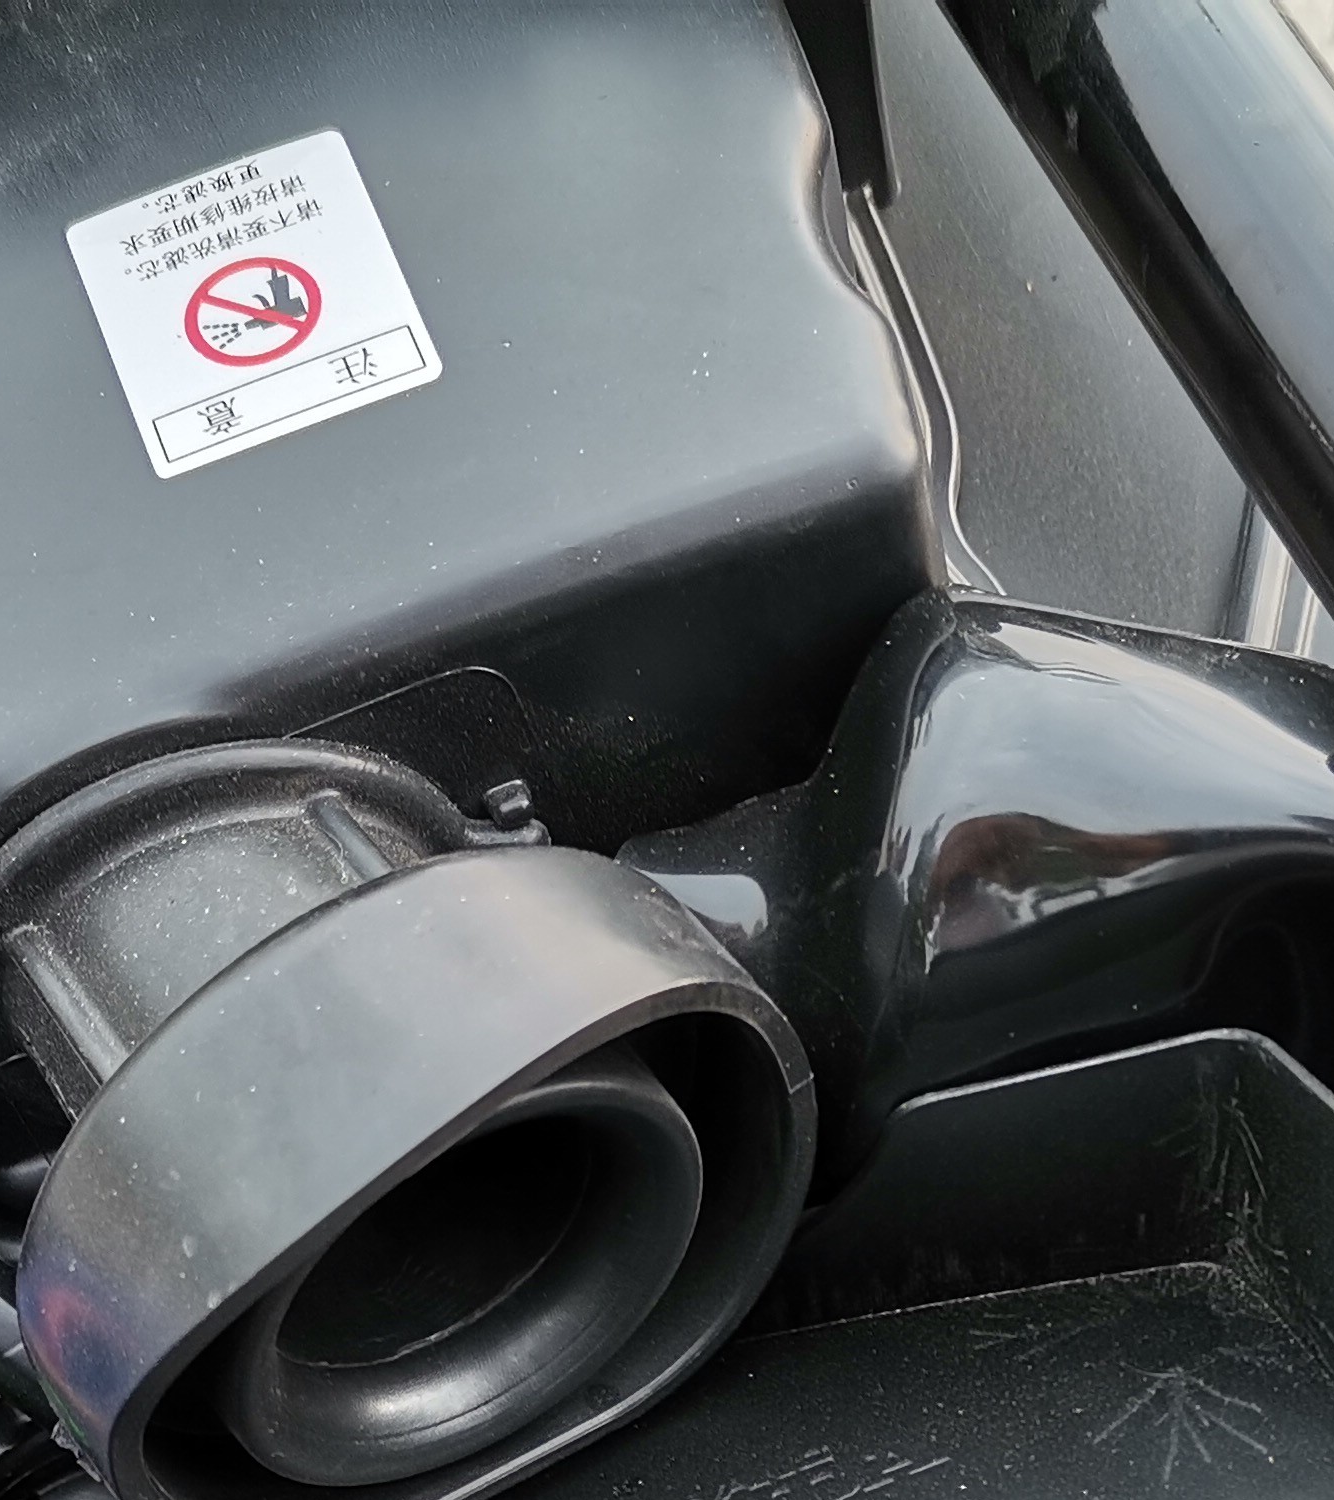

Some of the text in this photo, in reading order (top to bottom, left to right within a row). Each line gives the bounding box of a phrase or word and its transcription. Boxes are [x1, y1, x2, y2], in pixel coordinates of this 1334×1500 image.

[118, 174, 307, 257] 请按维修期要求
[142, 158, 263, 215] 更换滤芯。
[123, 198, 324, 282] 请不要清洗滤芯。
